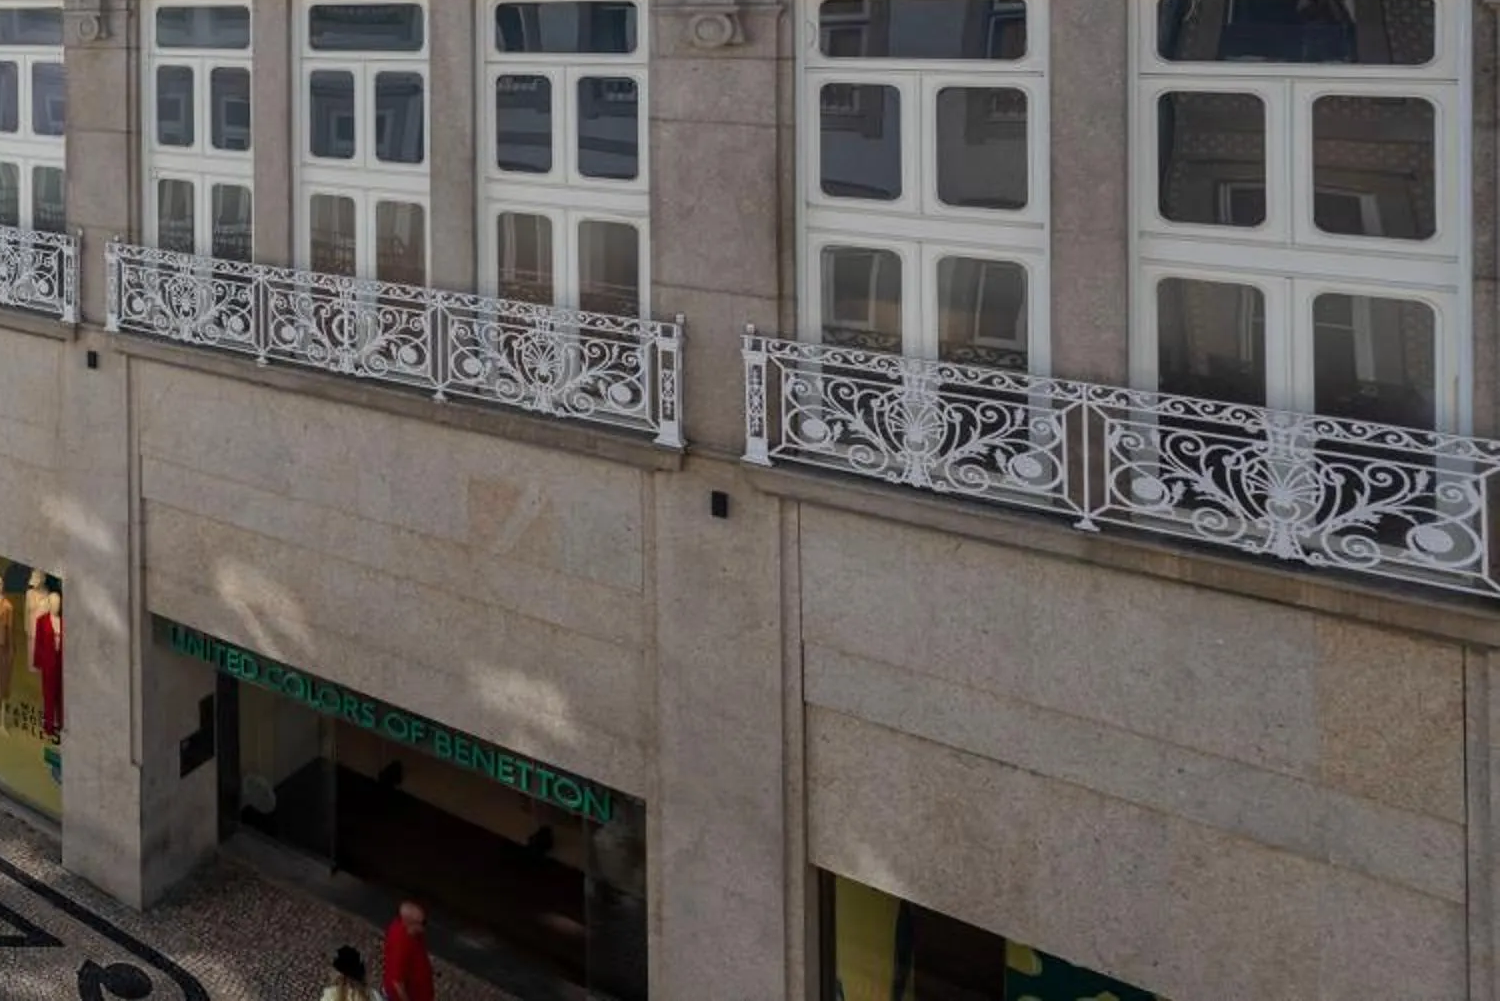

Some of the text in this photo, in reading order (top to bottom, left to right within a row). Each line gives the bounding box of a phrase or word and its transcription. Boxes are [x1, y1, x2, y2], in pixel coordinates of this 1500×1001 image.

[169, 623, 613, 823] UNITED COLORS OF BENETTON
